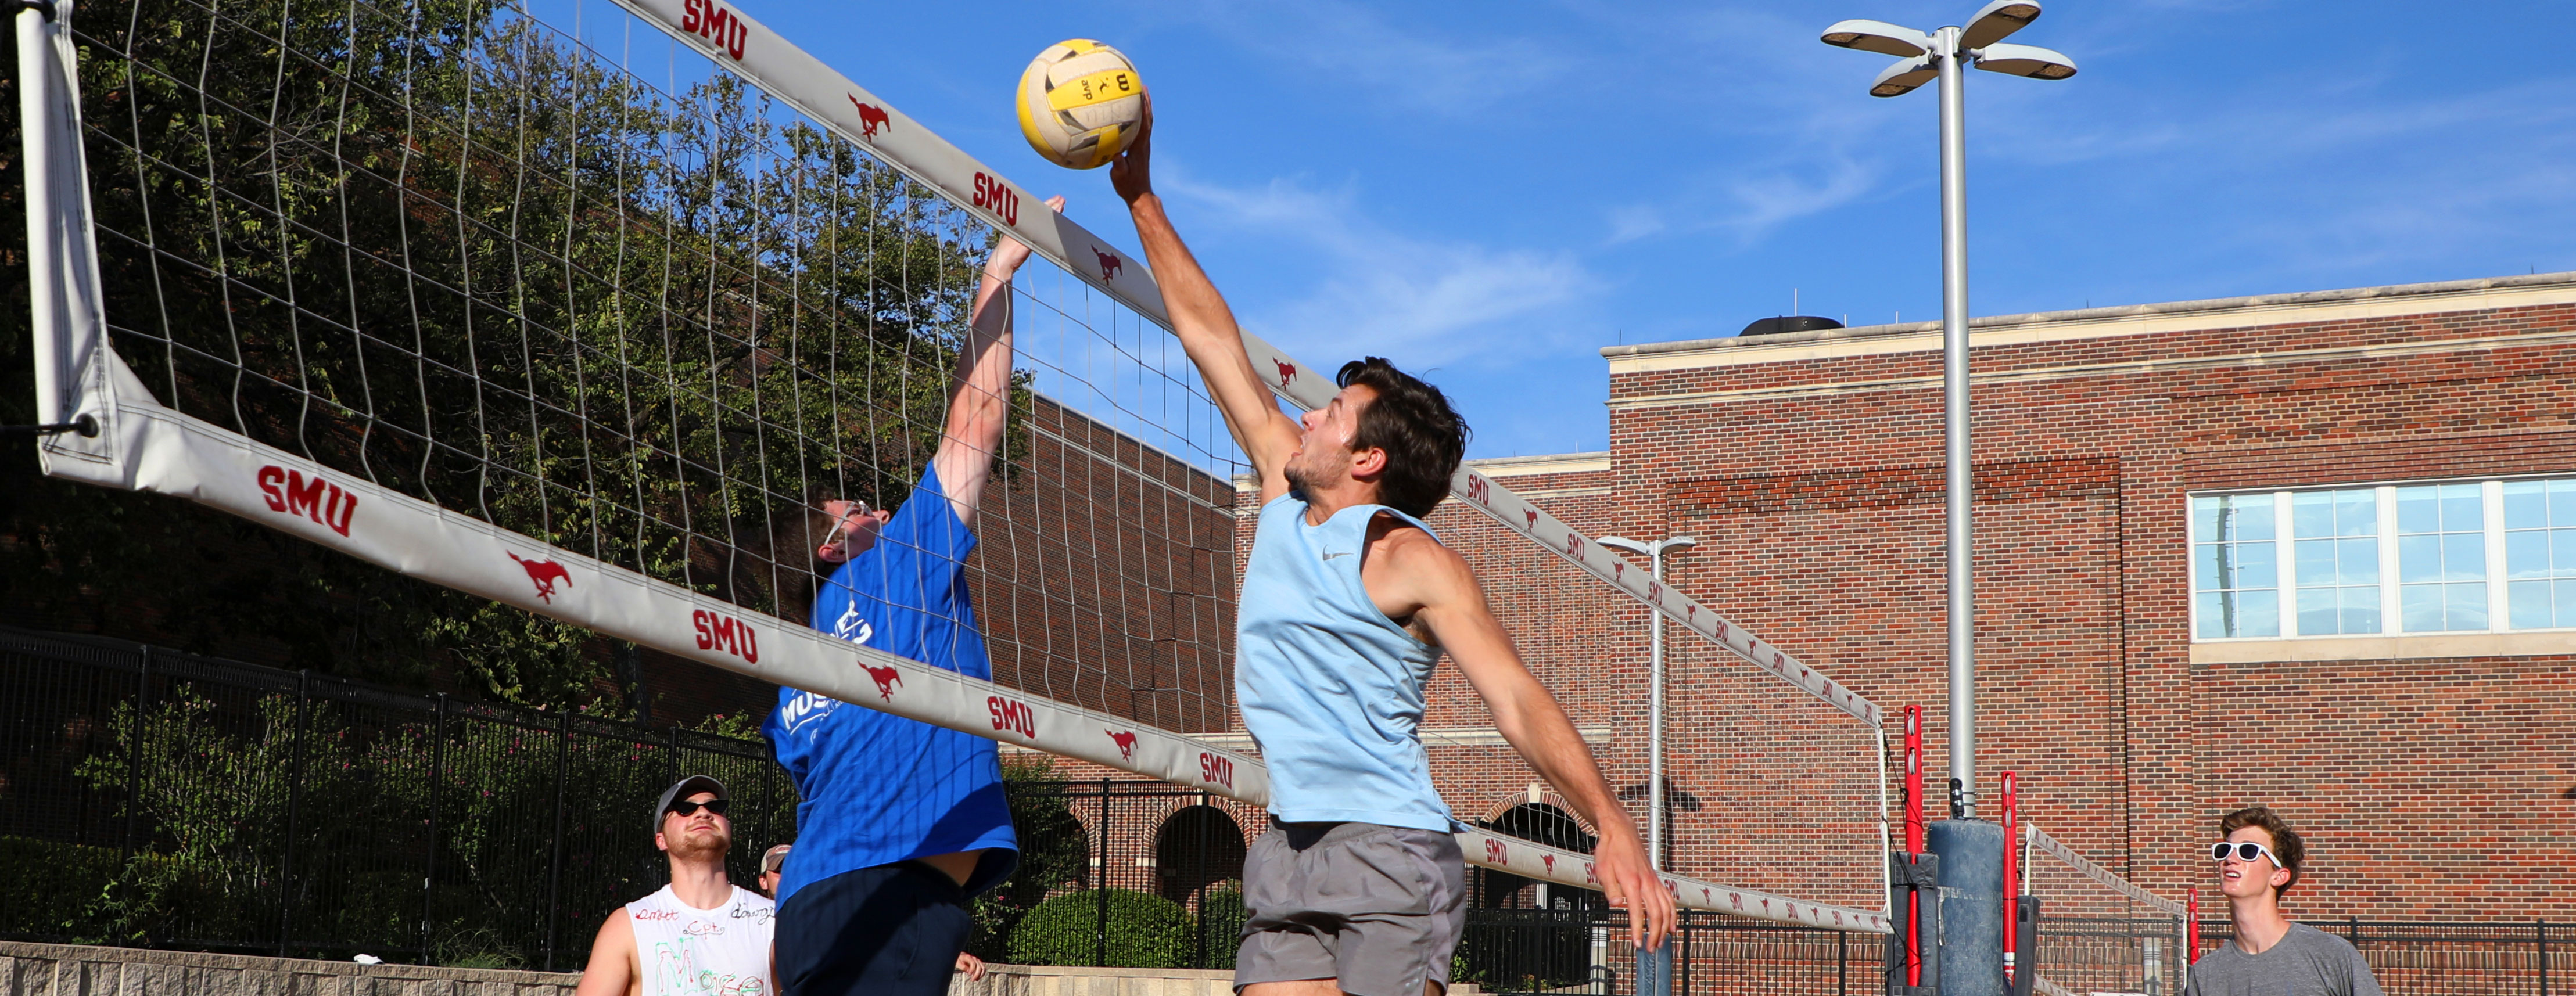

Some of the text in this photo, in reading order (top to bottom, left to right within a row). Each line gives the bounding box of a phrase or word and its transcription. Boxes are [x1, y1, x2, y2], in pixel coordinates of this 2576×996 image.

[683, 0, 747, 61] SMU
[1081, 80, 1093, 100] avp
[973, 172, 1019, 227] SMU
[257, 465, 358, 538] SMU
[1468, 474, 1489, 507] SMU
[1567, 533, 1584, 562] SMU
[1648, 581, 1663, 606] SMU
[693, 609, 758, 664] SMU
[1716, 620, 1729, 642] SMU
[987, 696, 1035, 739] SMU
[1200, 752, 1233, 789] SMU
[1485, 838, 1507, 866] SMU
[1585, 862, 1602, 886] SM
